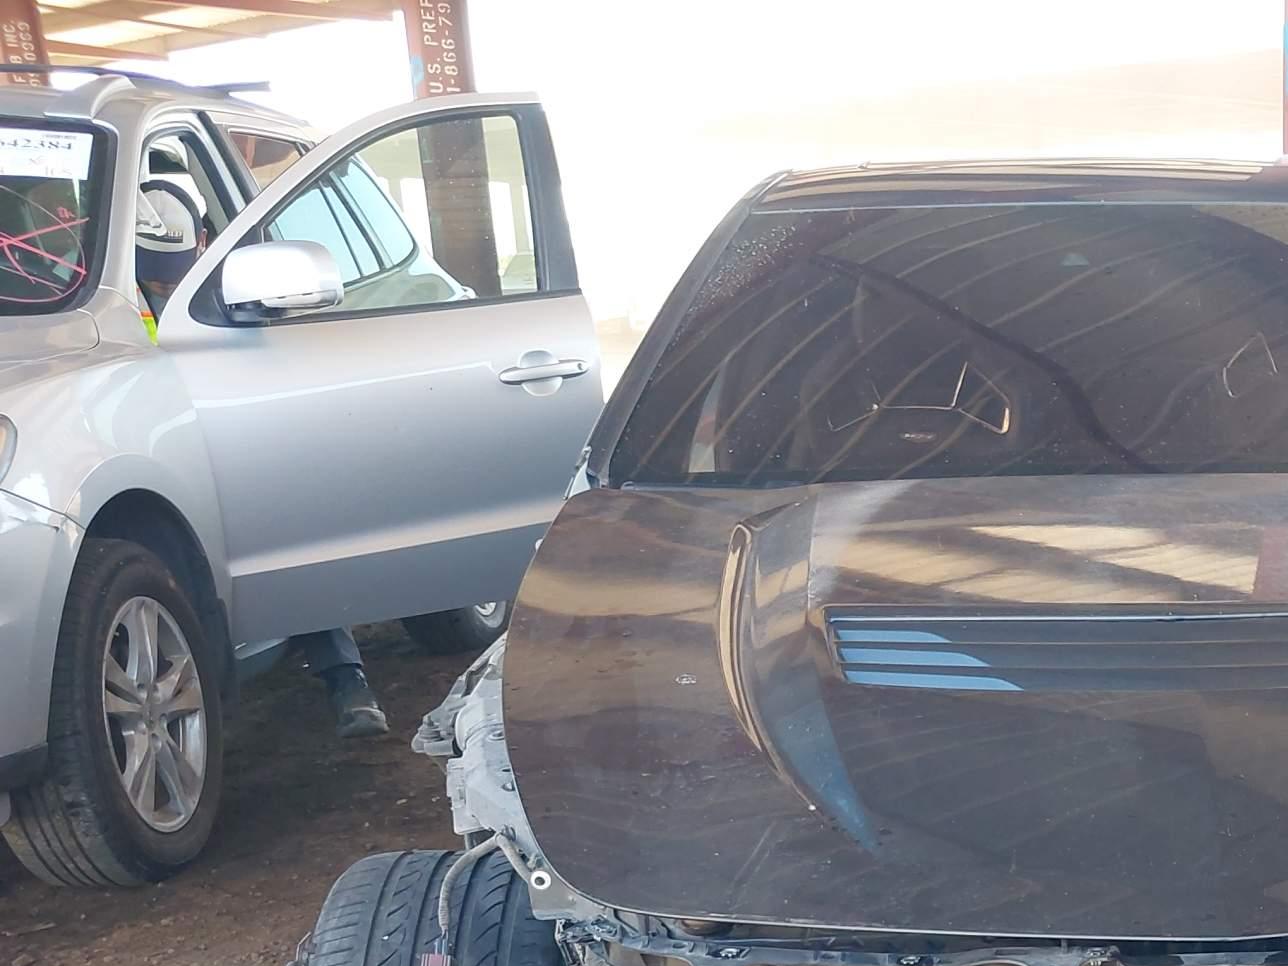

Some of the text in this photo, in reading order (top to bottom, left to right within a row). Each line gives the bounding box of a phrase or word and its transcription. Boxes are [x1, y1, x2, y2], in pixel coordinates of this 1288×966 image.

[438, 3, 461, 92] 1-866-79
[9, 55, 26, 83] FB
[427, 58, 443, 93] U.S.
